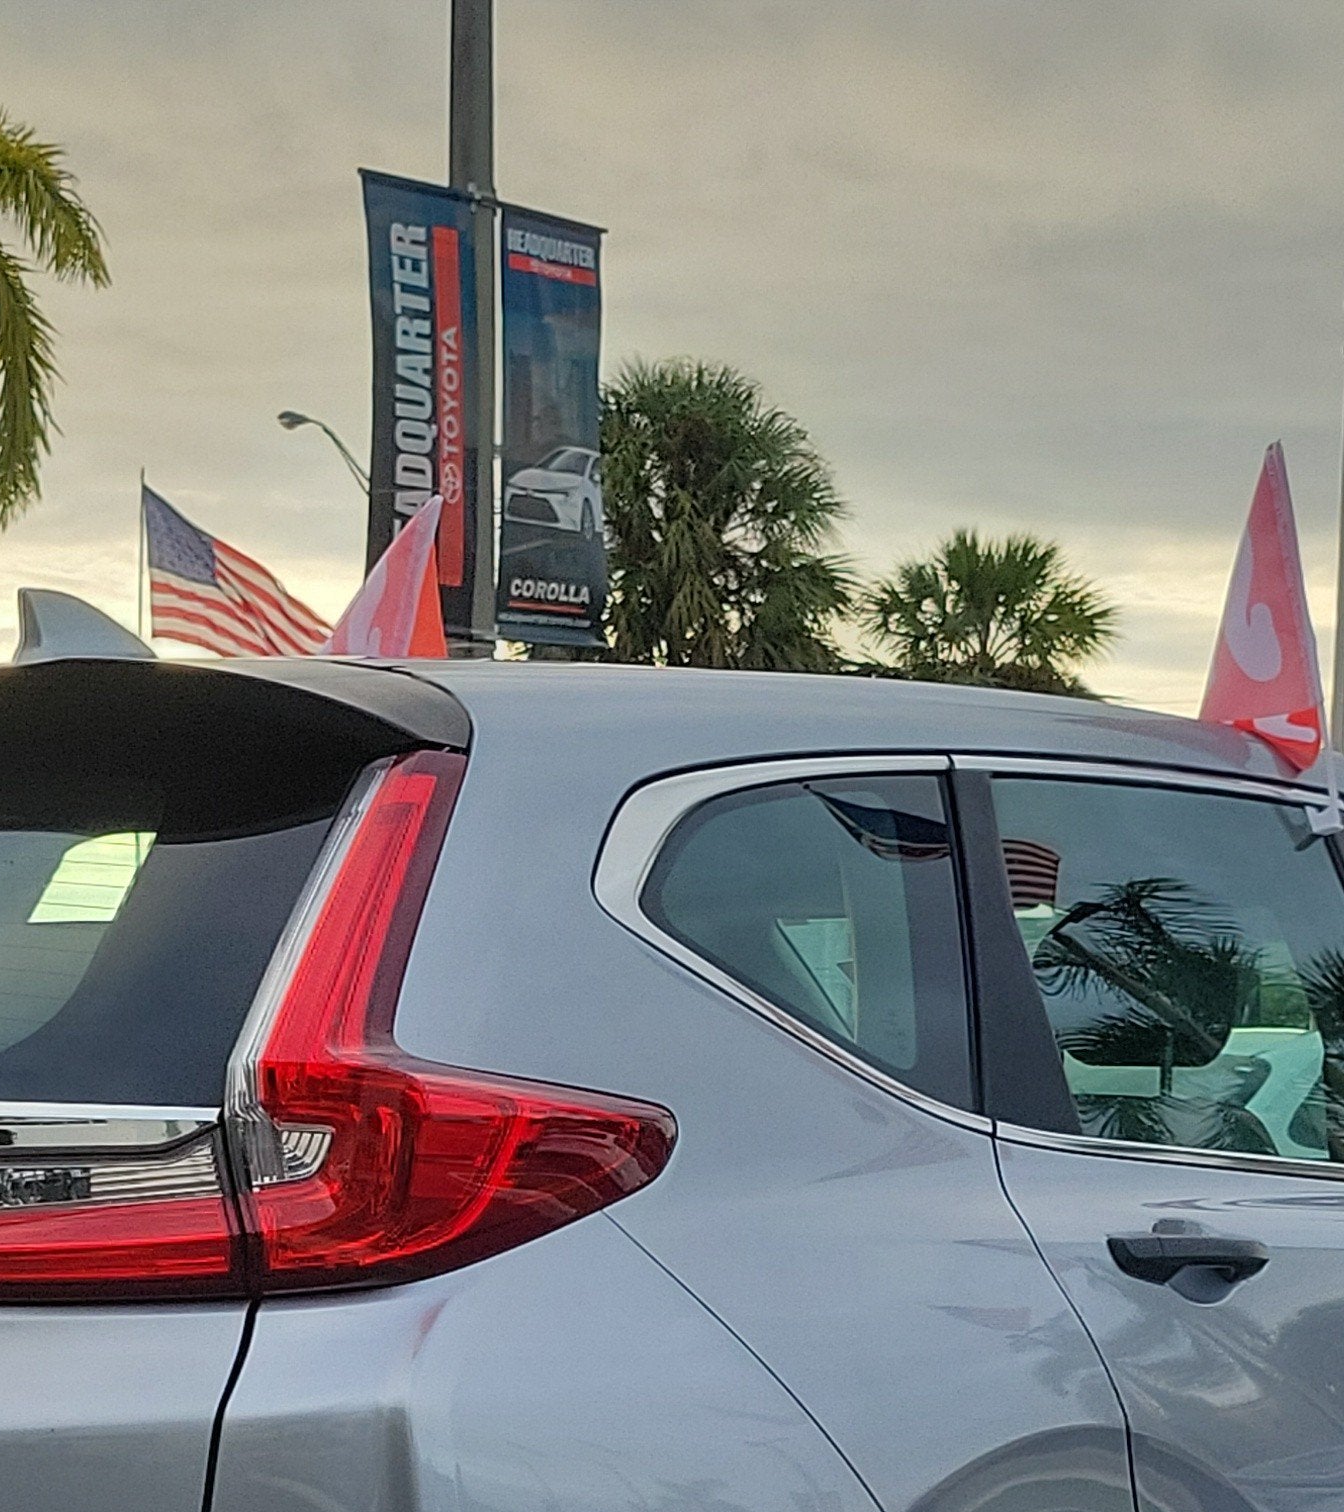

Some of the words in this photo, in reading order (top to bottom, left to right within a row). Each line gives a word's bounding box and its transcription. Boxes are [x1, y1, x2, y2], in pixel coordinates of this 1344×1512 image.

[506, 228, 595, 269] HEADQUARTER
[389, 221, 436, 541] ADQUARTER
[439, 326, 460, 460] TOYOTA
[510, 578, 590, 605] COROLLA
